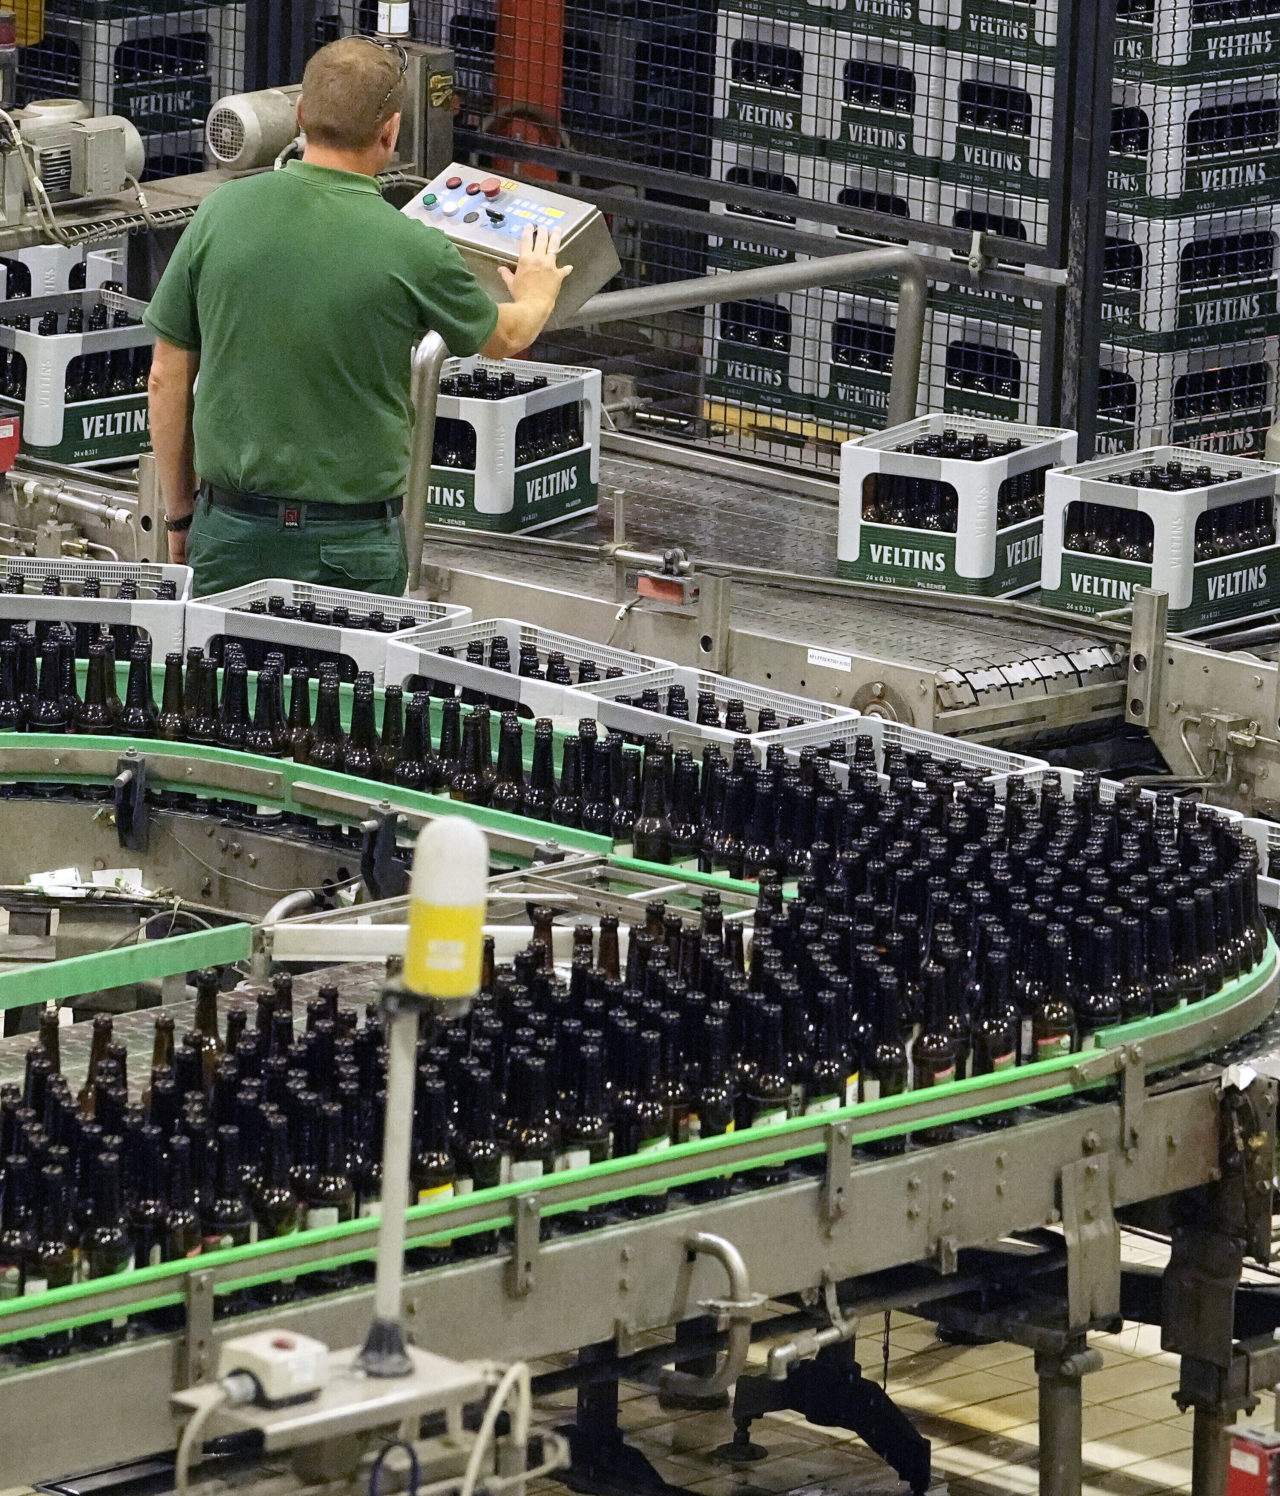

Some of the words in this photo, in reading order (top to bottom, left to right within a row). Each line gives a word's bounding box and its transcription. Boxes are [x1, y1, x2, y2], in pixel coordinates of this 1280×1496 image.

[969, 13, 1028, 40] VELTINS
[1113, 39, 1145, 60] TINS
[1207, 30, 1272, 60] VELTINS
[736, 102, 794, 130] VELTINS
[849, 123, 907, 150] VELTINS
[963, 145, 1022, 172] VELTINS
[1106, 170, 1140, 192] TINS
[1200, 162, 1267, 193] VELTINS
[1100, 303, 1133, 325] TINS
[1194, 295, 1260, 326] VELTINS
[726, 360, 782, 387] VELTINS
[81, 408, 149, 440] VELTIN
[426, 485, 465, 508] TINS
[525, 465, 578, 504] VELTINS
[870, 543, 946, 572] VELTINS
[1006, 533, 1043, 568] VELTI
[1207, 564, 1267, 601] VELTINS
